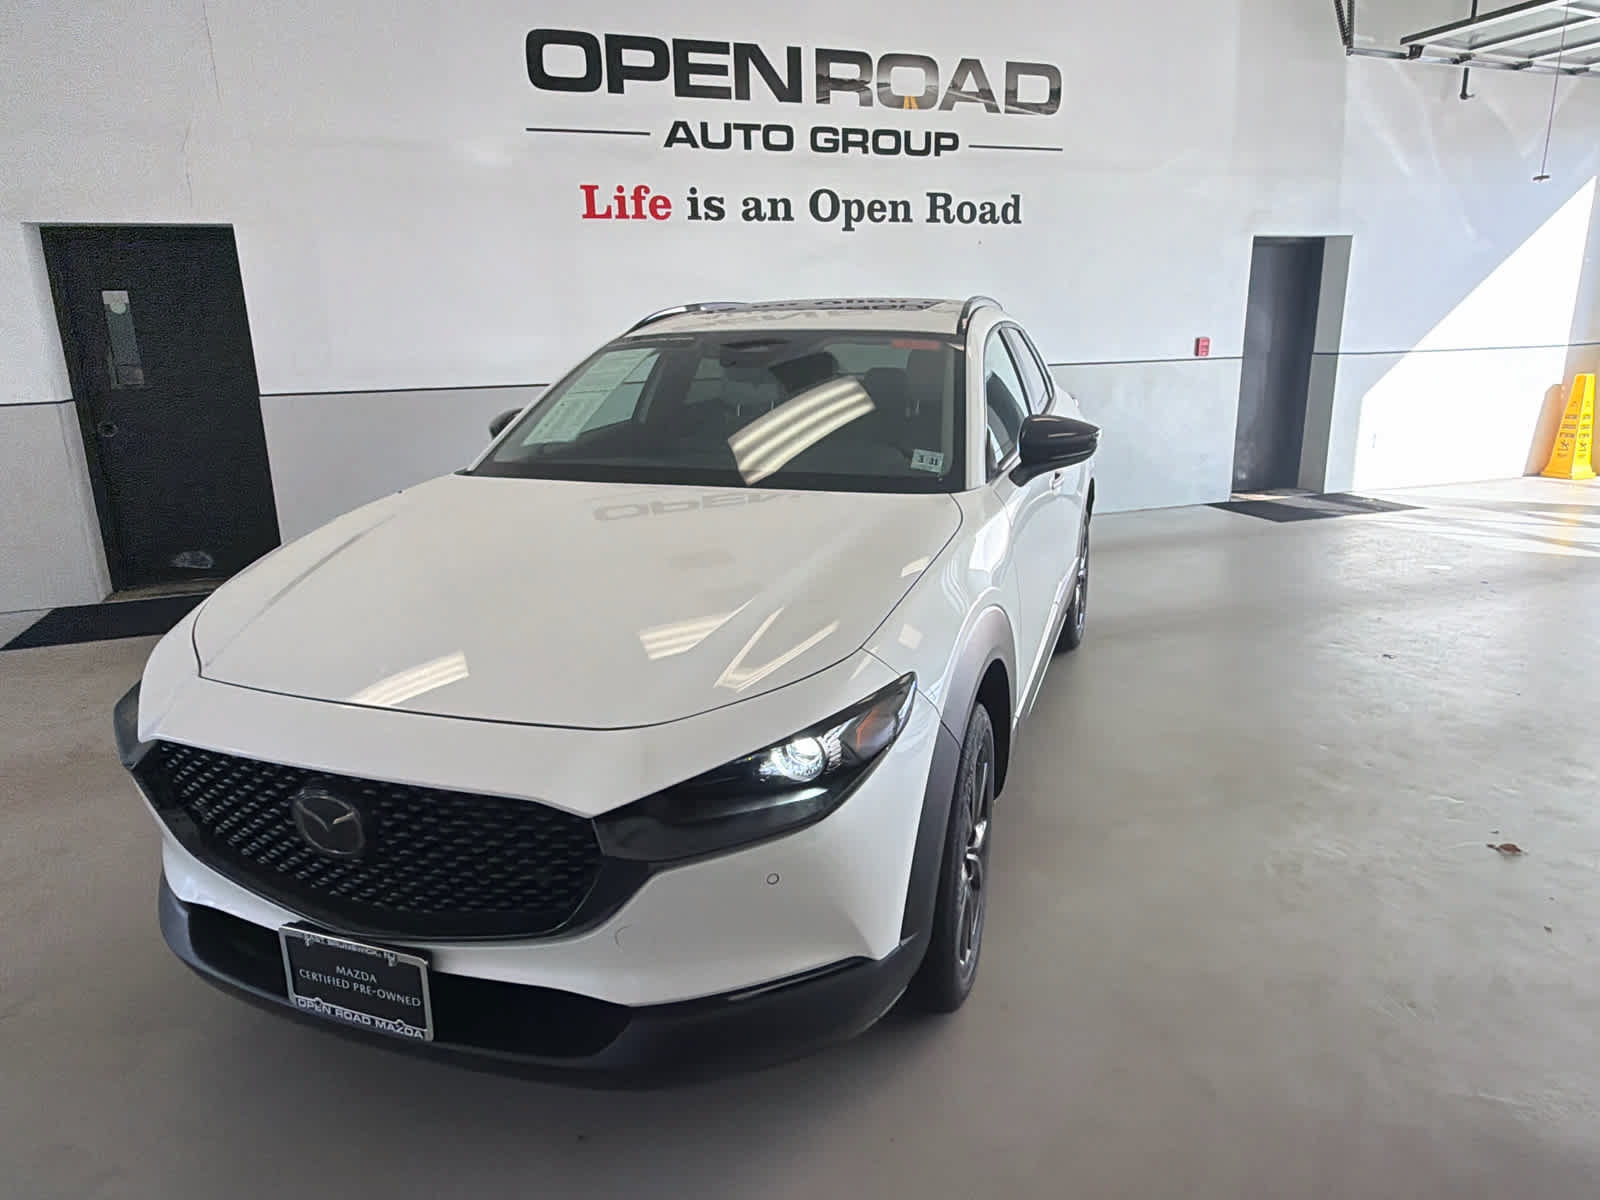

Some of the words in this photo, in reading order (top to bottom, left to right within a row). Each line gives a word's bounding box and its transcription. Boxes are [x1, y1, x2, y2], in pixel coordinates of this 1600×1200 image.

[525, 28, 802, 104] OPEN
[815, 47, 1062, 116] ROAD
[663, 120, 794, 152] AUTO
[809, 126, 960, 157] GROUP
[580, 184, 672, 220] Life
[687, 187, 726, 222] is
[741, 196, 795, 222] an
[808, 188, 913, 232] Open
[925, 191, 1022, 225] Road
[299, 968, 350, 989] CERTIFIED
[353, 983, 421, 1006] PRE-OWNED
[336, 965, 377, 983] MAZDA
[298, 998, 331, 1015] OPEN
[335, 1008, 371, 1025] ROAD
[375, 1019, 423, 1039] MAZDA
